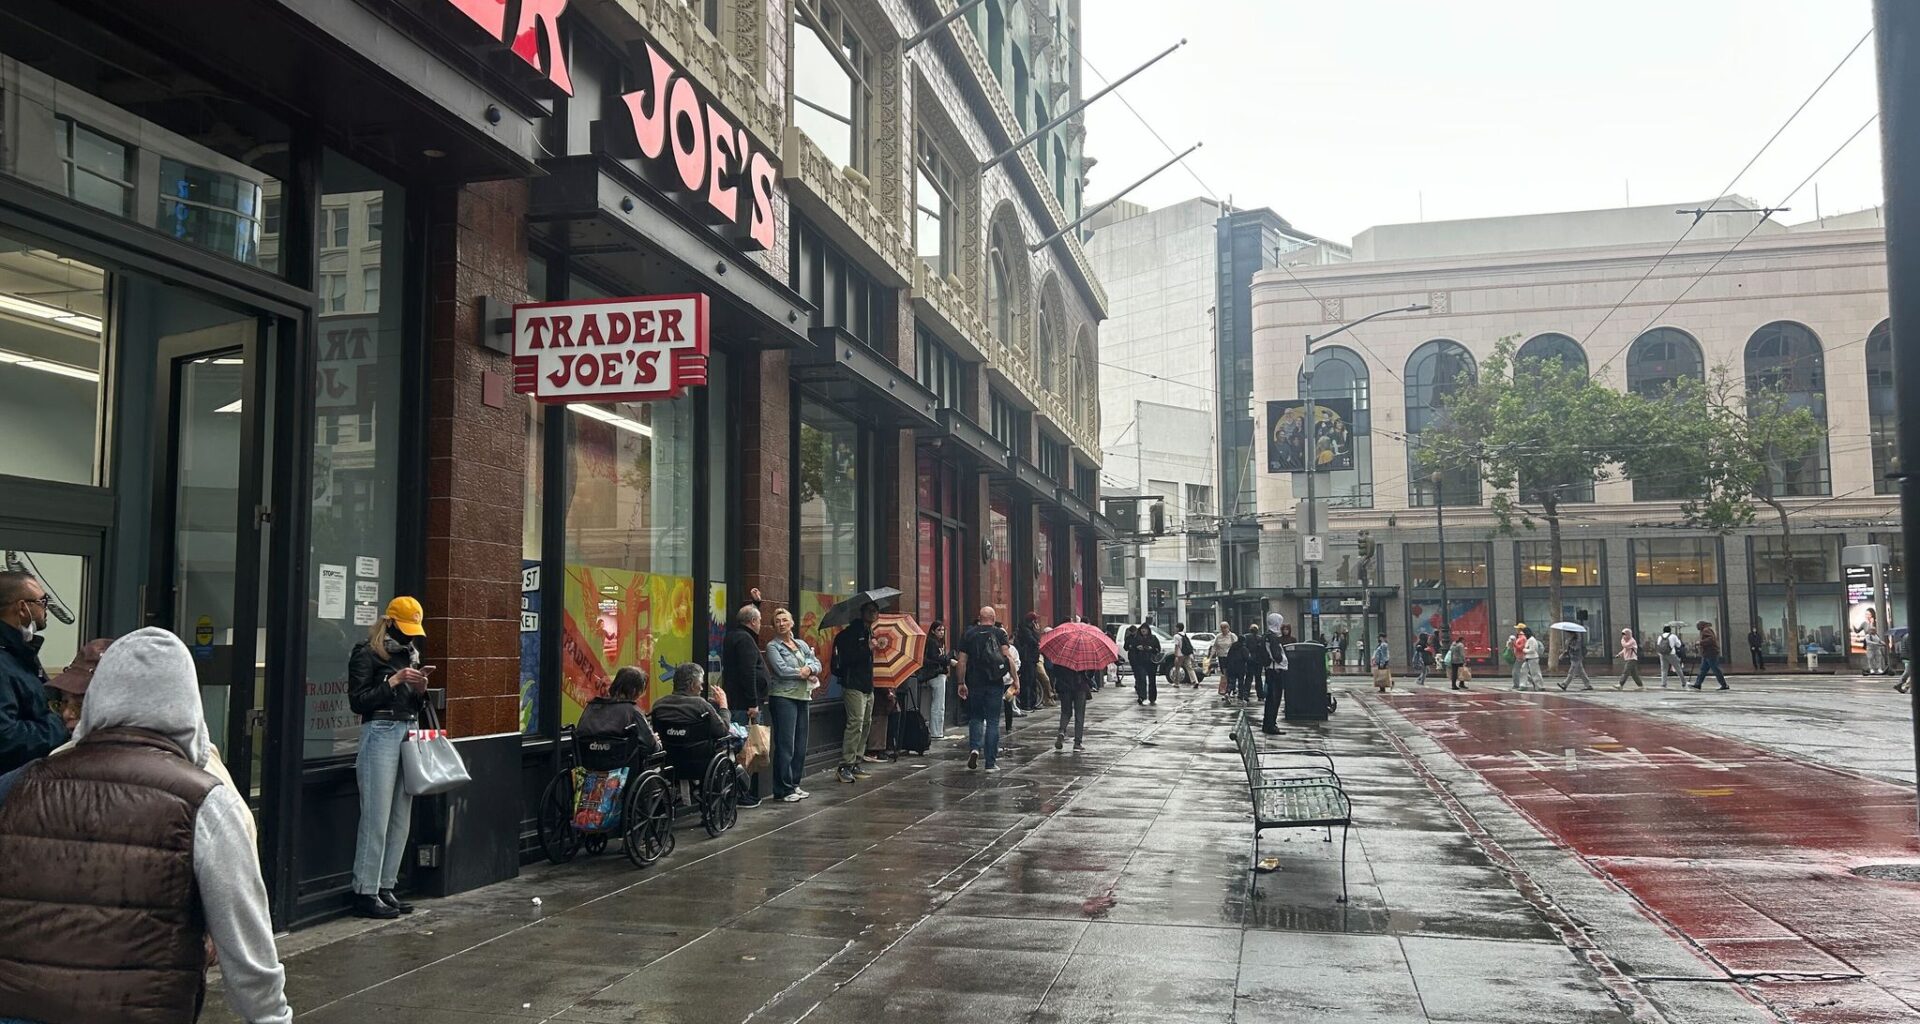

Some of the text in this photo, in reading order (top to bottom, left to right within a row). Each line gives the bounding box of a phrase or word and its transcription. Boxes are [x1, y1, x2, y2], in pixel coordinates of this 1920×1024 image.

[621, 40, 776, 251] JOE'S
[524, 308, 685, 349] TRADER
[547, 350, 661, 388] JOE'S
[526, 570, 538, 588] ST
[317, 716, 343, 730] DAYS
[667, 728, 687, 736] drive
[589, 741, 611, 751] drive
